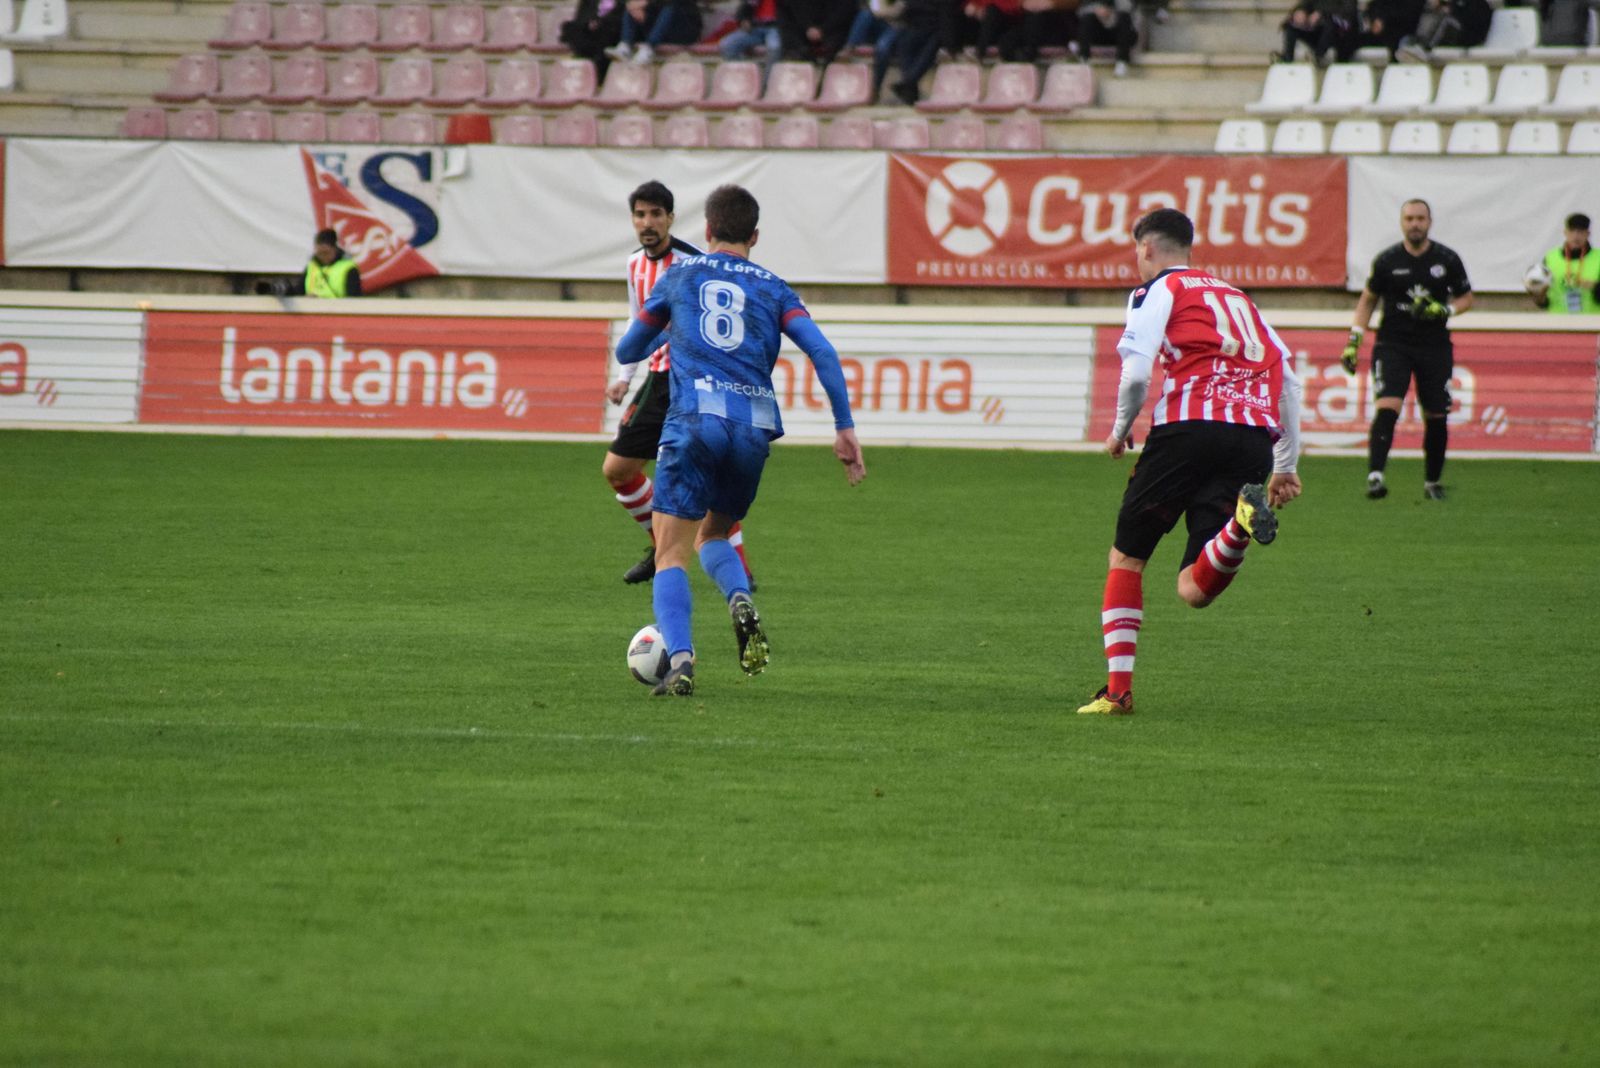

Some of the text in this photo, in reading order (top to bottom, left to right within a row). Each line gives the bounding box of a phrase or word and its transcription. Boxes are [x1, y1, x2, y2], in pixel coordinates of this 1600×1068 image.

[680, 255, 773, 280] JUAN LÓPEZ
[698, 279, 746, 352] 8
[1202, 290, 1266, 363] 10
[219, 326, 498, 409] lantania
